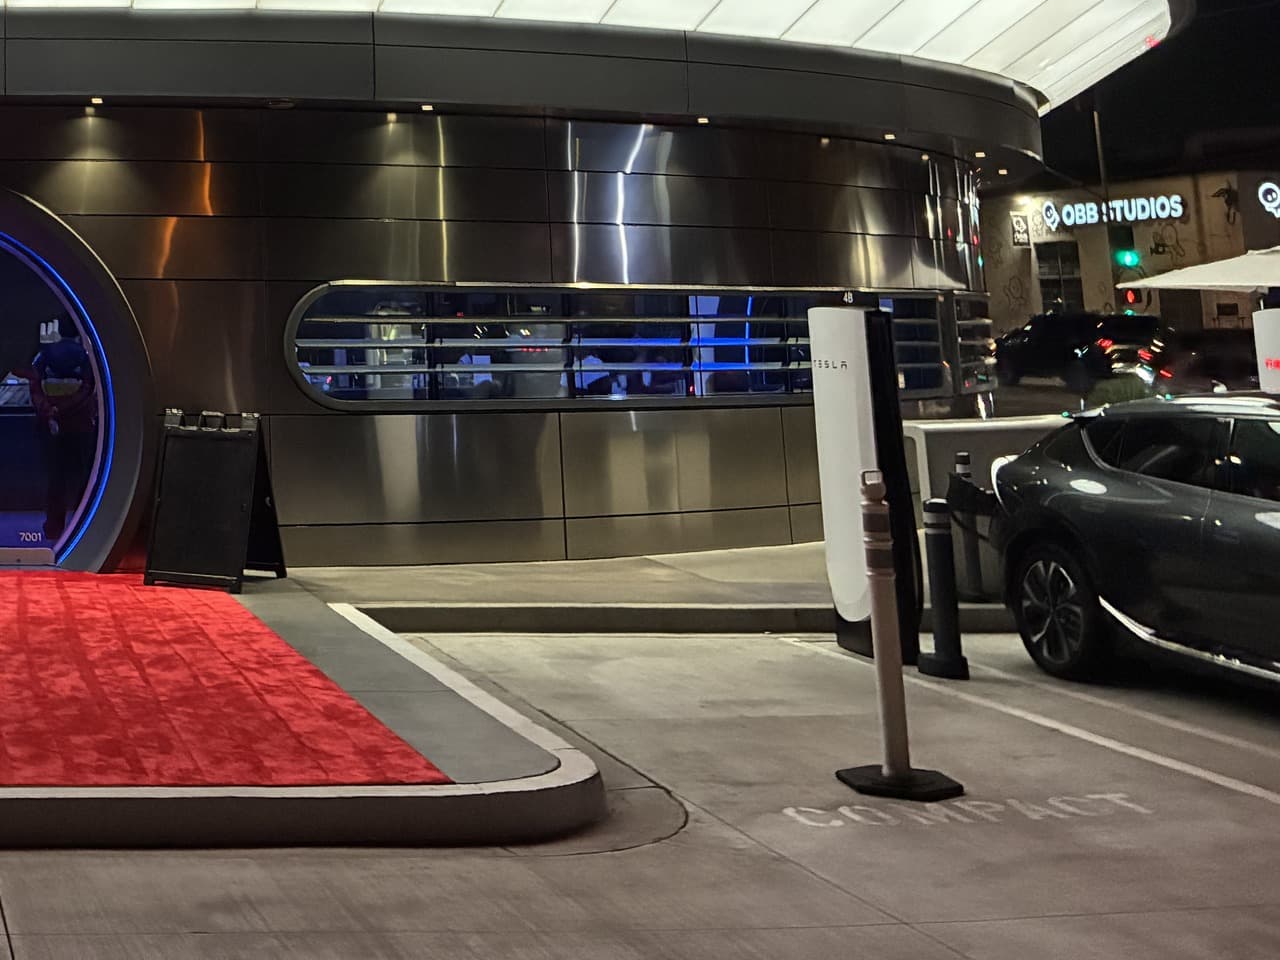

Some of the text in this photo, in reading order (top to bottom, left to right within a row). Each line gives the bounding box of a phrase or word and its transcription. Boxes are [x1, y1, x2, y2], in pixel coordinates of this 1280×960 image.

[1061, 194, 1183, 226] OBB STUDIOS
[19, 532, 42, 542] 7001
[782, 792, 1154, 827] COMPACT
